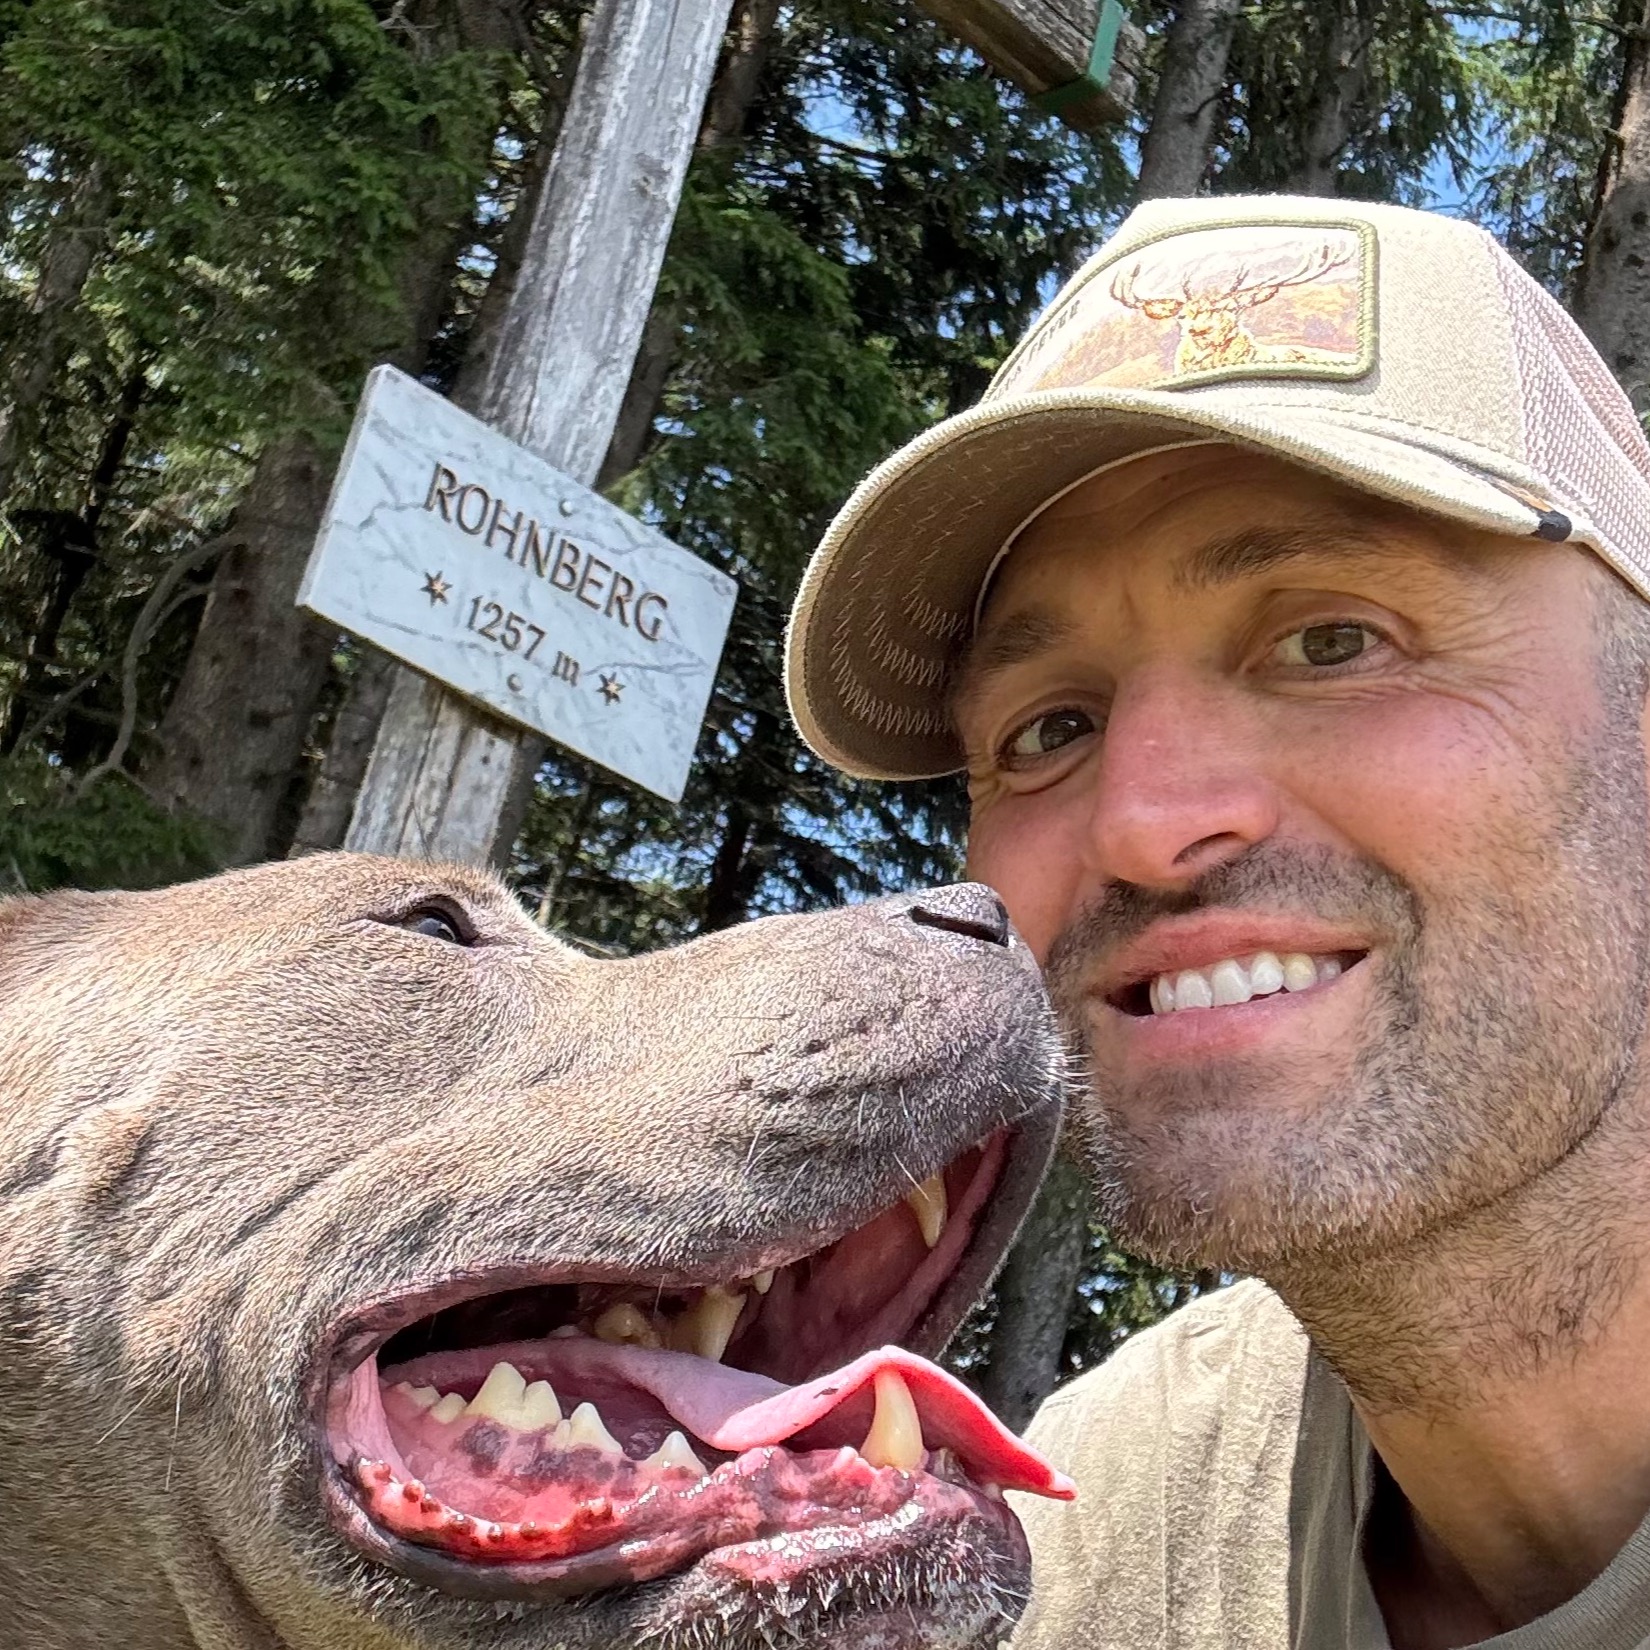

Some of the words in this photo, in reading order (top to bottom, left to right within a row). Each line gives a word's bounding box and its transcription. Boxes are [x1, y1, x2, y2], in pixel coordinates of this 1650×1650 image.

[424, 462, 668, 642] ROHNBERG
[466, 595, 546, 661] 1257
[551, 650, 581, 687] m
